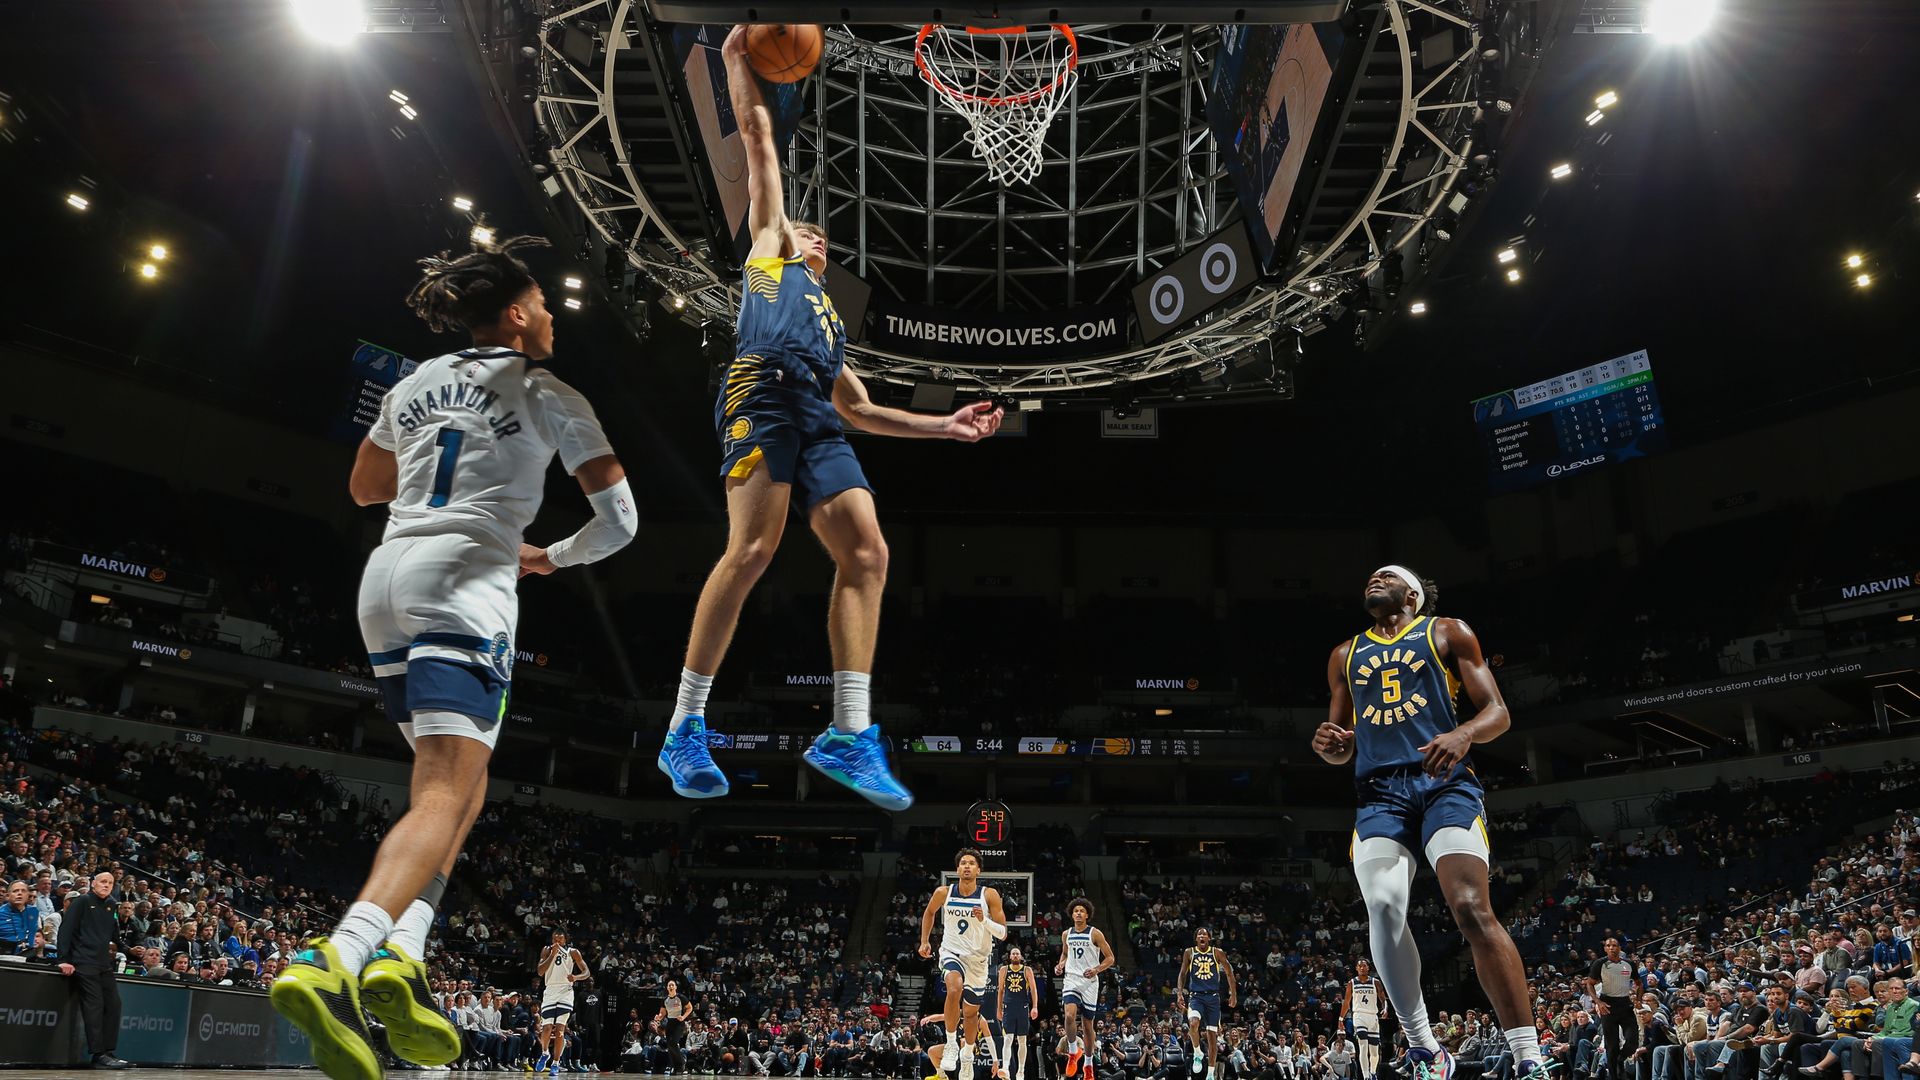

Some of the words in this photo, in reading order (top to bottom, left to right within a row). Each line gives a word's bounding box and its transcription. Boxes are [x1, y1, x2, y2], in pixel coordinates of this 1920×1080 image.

[886, 315, 1117, 346] TIMBERWOLVES.COM
[398, 383, 502, 432] SHANNON
[489, 410, 522, 440] JR
[1494, 423, 1521, 436] Shannon
[1496, 430, 1529, 444] Dillingham
[1501, 451, 1523, 462] Juzang
[1642, 413, 1654, 422] 0/0
[1498, 442, 1520, 453] Hyland
[1502, 459, 1529, 471] Beringer
[1644, 422, 1656, 432] 0/0
[426, 427, 466, 508] 1
[1562, 454, 1606, 471] LEXUS
[81, 554, 146, 578] MARVIN
[1842, 576, 1910, 599] MARVIN
[132, 640, 178, 656] MARVIN
[1355, 648, 1426, 686] INDIANA
[340, 680, 378, 694] Windows
[1136, 680, 1184, 688] MARVIN
[1380, 668, 1402, 704] 5
[1624, 695, 1665, 707] Windows
[1666, 690, 1684, 700] and
[1686, 685, 1713, 697] doors
[1715, 680, 1750, 693] custom
[1752, 674, 1787, 687] crafted
[1789, 671, 1803, 680] for
[1806, 668, 1828, 681] your
[1830, 663, 1862, 674] vision
[1362, 693, 1428, 726] PACERS
[512, 714, 532, 723] vision
[185, 732, 202, 743] 136
[736, 734, 754, 742] SPORTS
[976, 739, 1003, 750] 5:44
[937, 741, 952, 751] 64
[1028, 742, 1043, 752] 86
[1793, 754, 1811, 764] 106
[981, 810, 1004, 822] 5:43
[976, 822, 1003, 842] 21
[957, 919, 969, 935] 9
[555, 955, 562, 966] 8
[1073, 948, 1084, 959] 19
[1362, 995, 1368, 1004] 4
[120, 1015, 173, 1032] CFMOTO
[215, 1022, 261, 1037] CFMOTO
